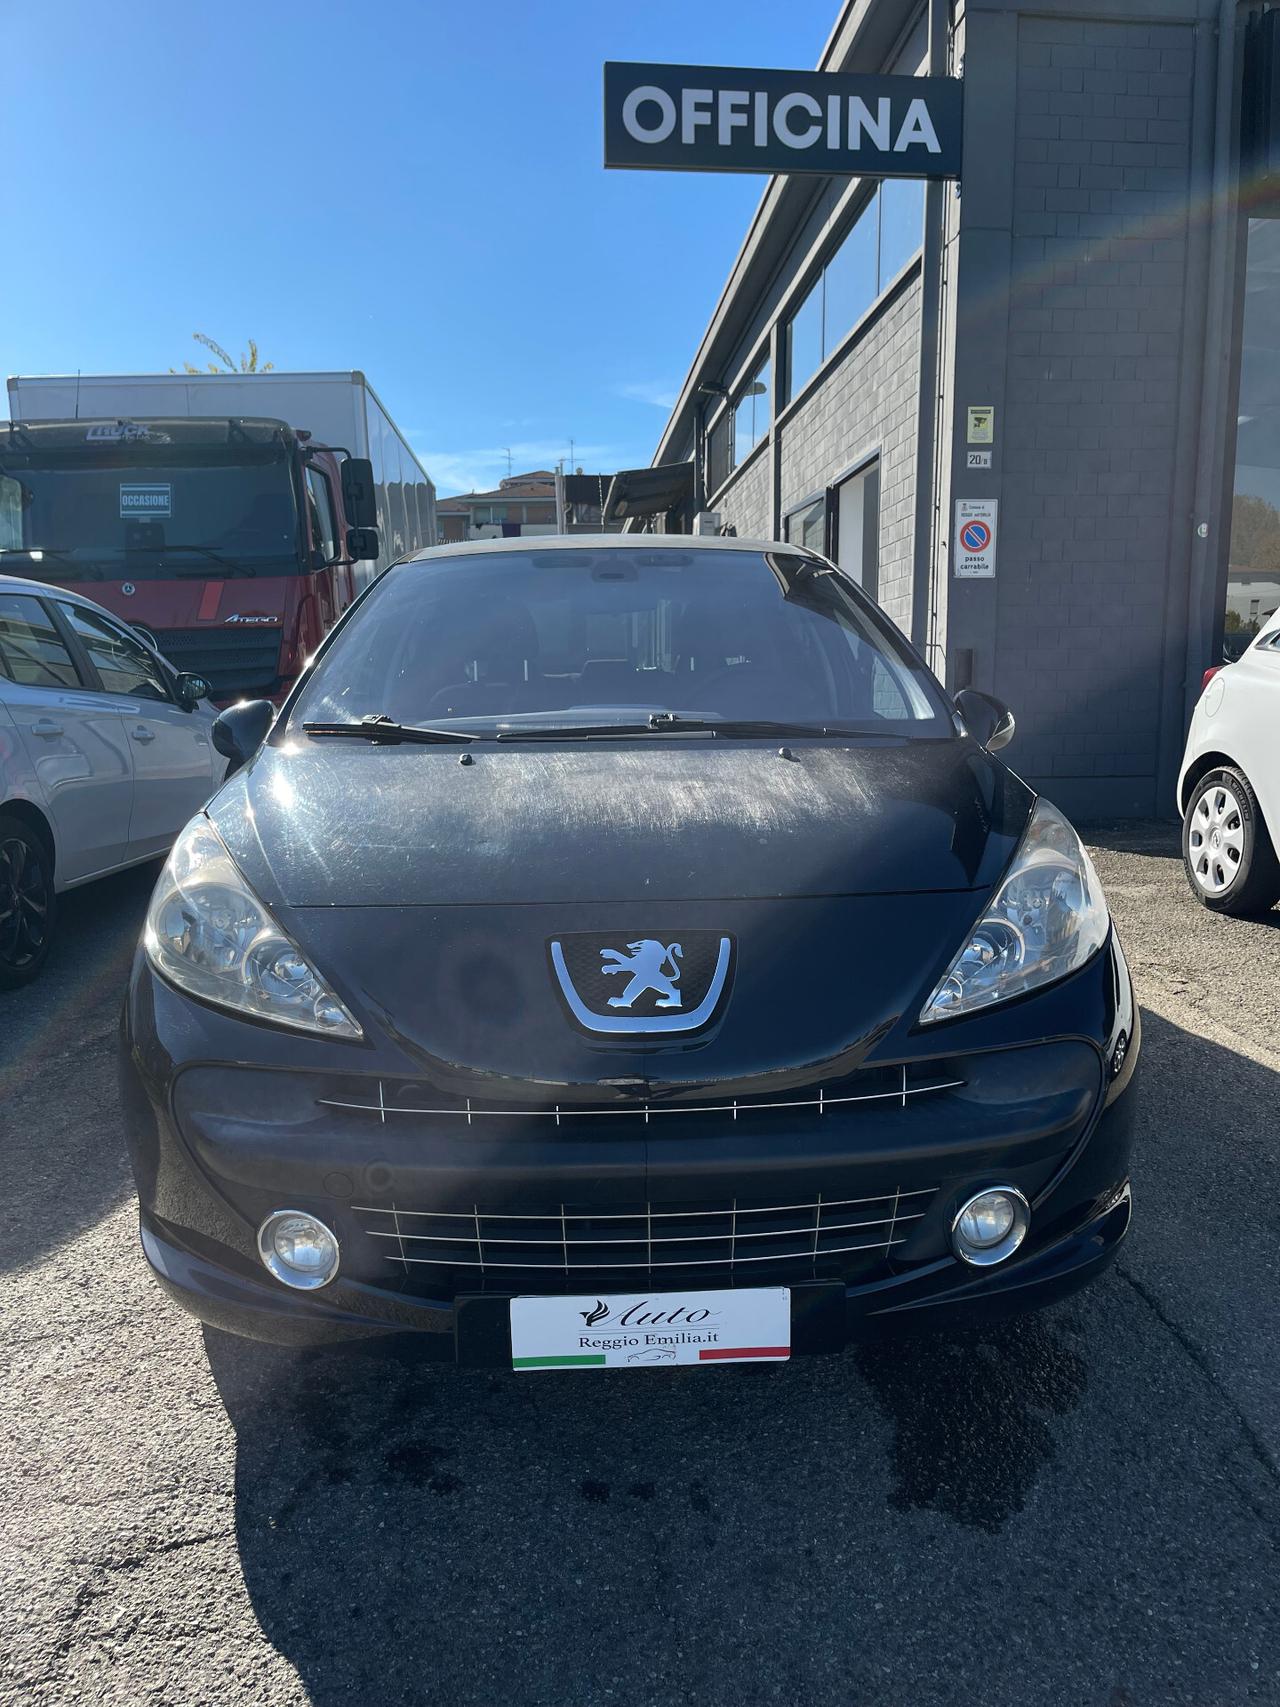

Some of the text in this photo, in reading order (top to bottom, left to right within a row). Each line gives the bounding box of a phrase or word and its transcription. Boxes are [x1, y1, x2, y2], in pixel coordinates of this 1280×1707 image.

[622, 84, 942, 154] OFFICINA
[122, 494, 169, 506] OCCASIONE
[597, 1300, 722, 1326] Auto
[579, 1331, 720, 1351] Reggio Emilia.it
